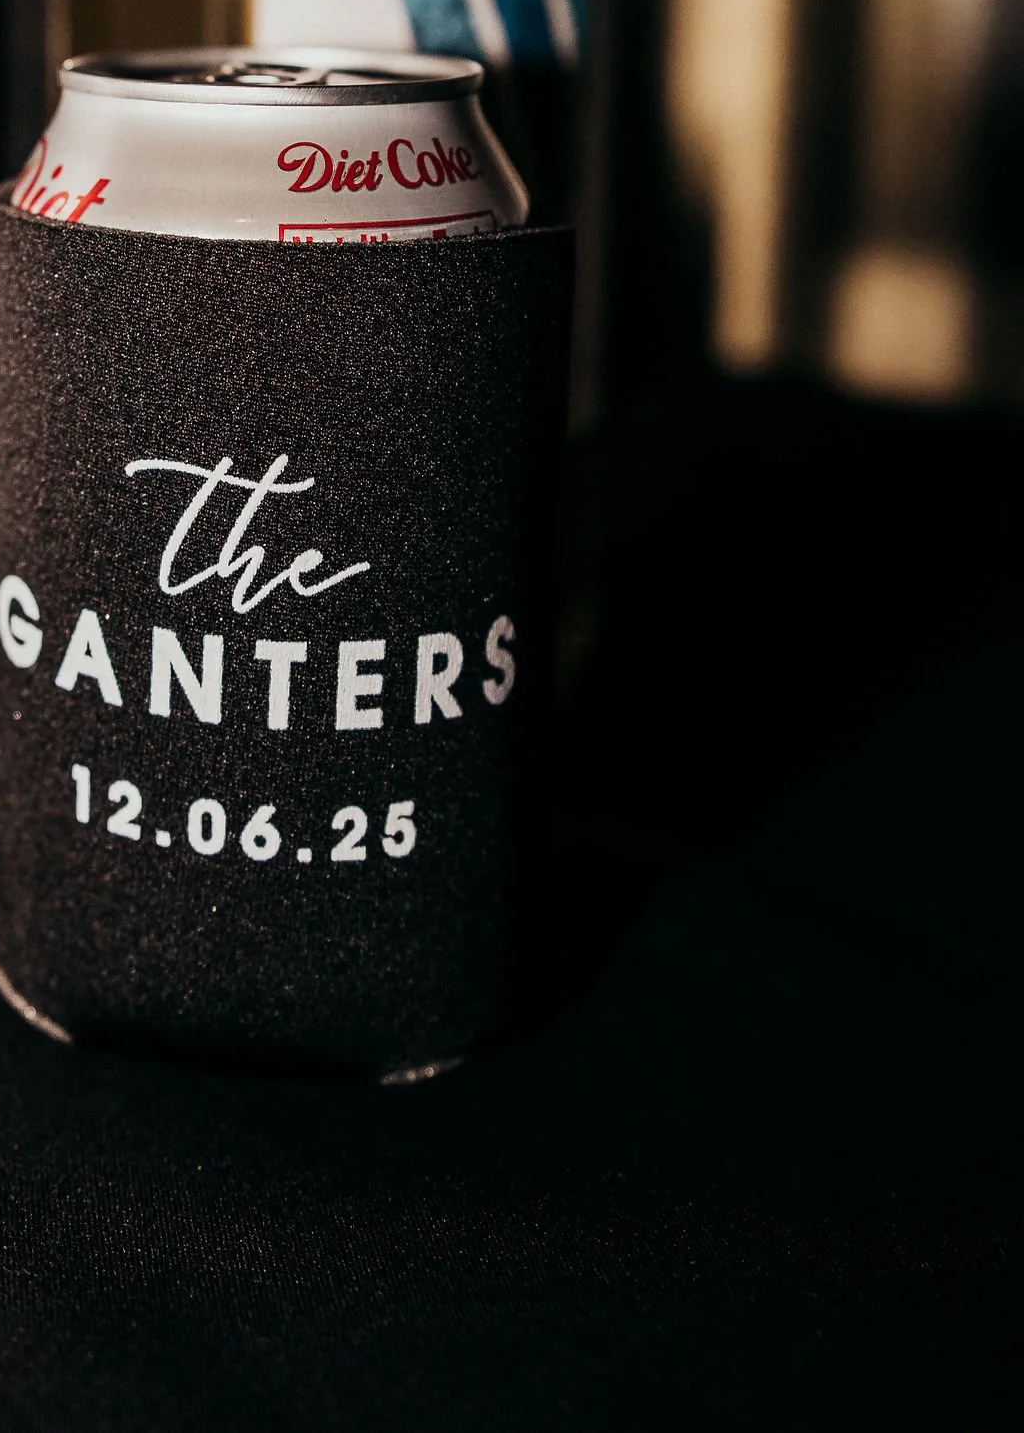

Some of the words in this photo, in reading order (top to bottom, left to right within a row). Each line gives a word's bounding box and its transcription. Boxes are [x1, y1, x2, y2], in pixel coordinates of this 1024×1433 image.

[277, 141, 383, 193] Diet
[386, 137, 479, 190] Coke
[125, 453, 371, 615] the
[71, 763, 418, 863] 12.06.25
